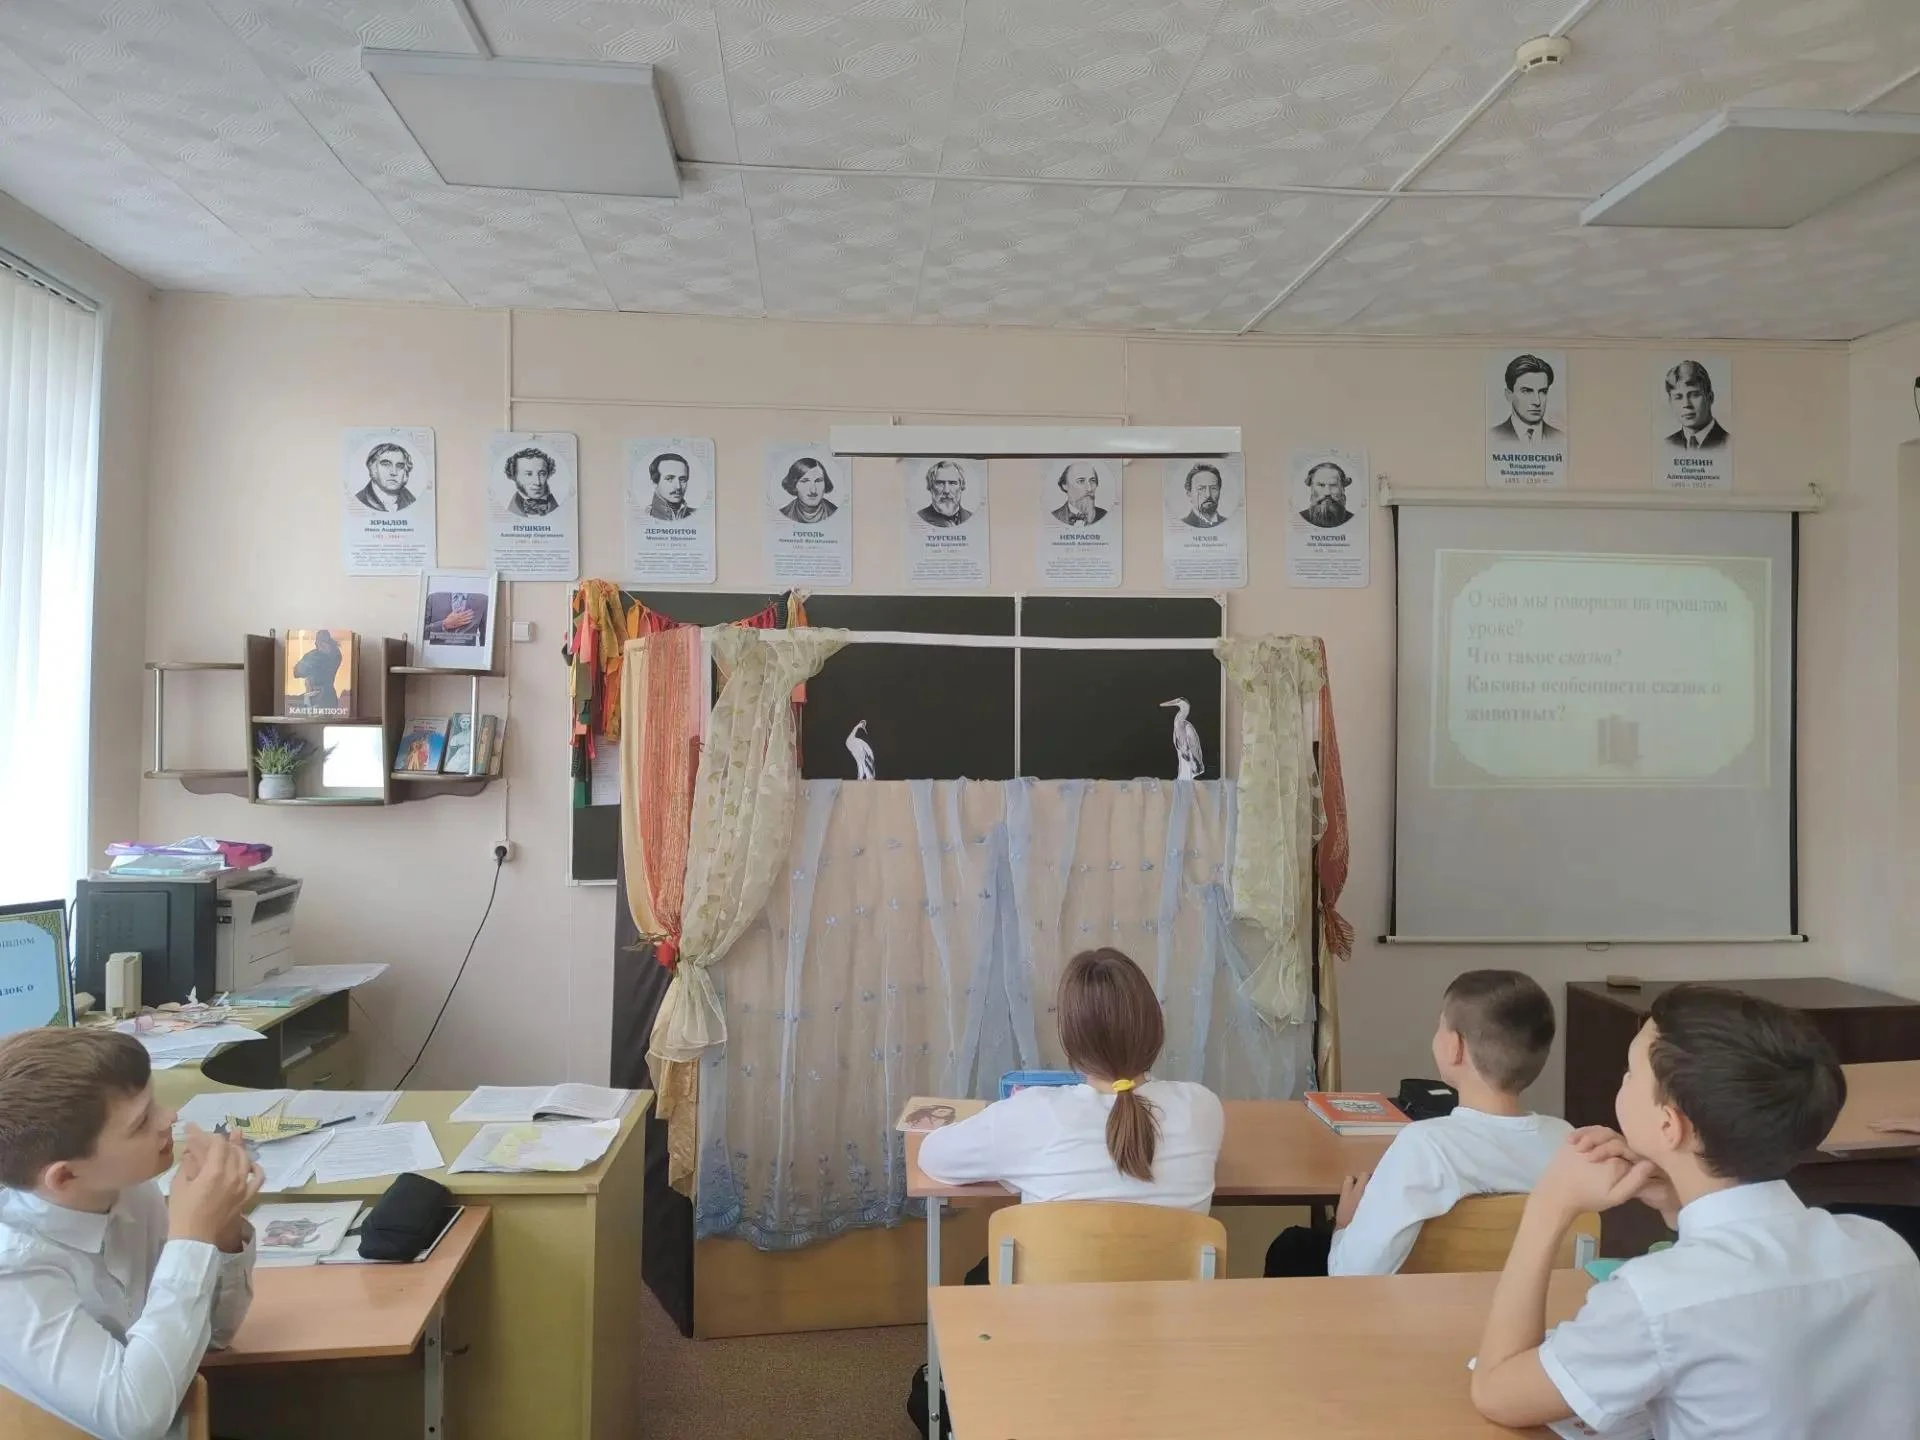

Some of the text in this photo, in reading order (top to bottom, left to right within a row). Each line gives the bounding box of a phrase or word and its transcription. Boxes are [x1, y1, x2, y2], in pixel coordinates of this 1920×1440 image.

[1492, 453, 1563, 463] МАЯКОВСКИЙ
[1673, 458, 1713, 467] ЕСЕНИН
[370, 519, 408, 527] КРЫЛОВ
[644, 528, 697, 536] ЛЕРМОНТОВ
[792, 531, 825, 539] ГОГОЛЬ
[1310, 534, 1346, 542] ТОЛСТОЙ
[1468, 590, 1480, 608] О
[1523, 594, 1548, 609] мы
[1467, 646, 1500, 666] Что
[1507, 650, 1553, 666] такое
[1466, 675, 1535, 695] Каковы
[1464, 704, 1566, 723] животных?
